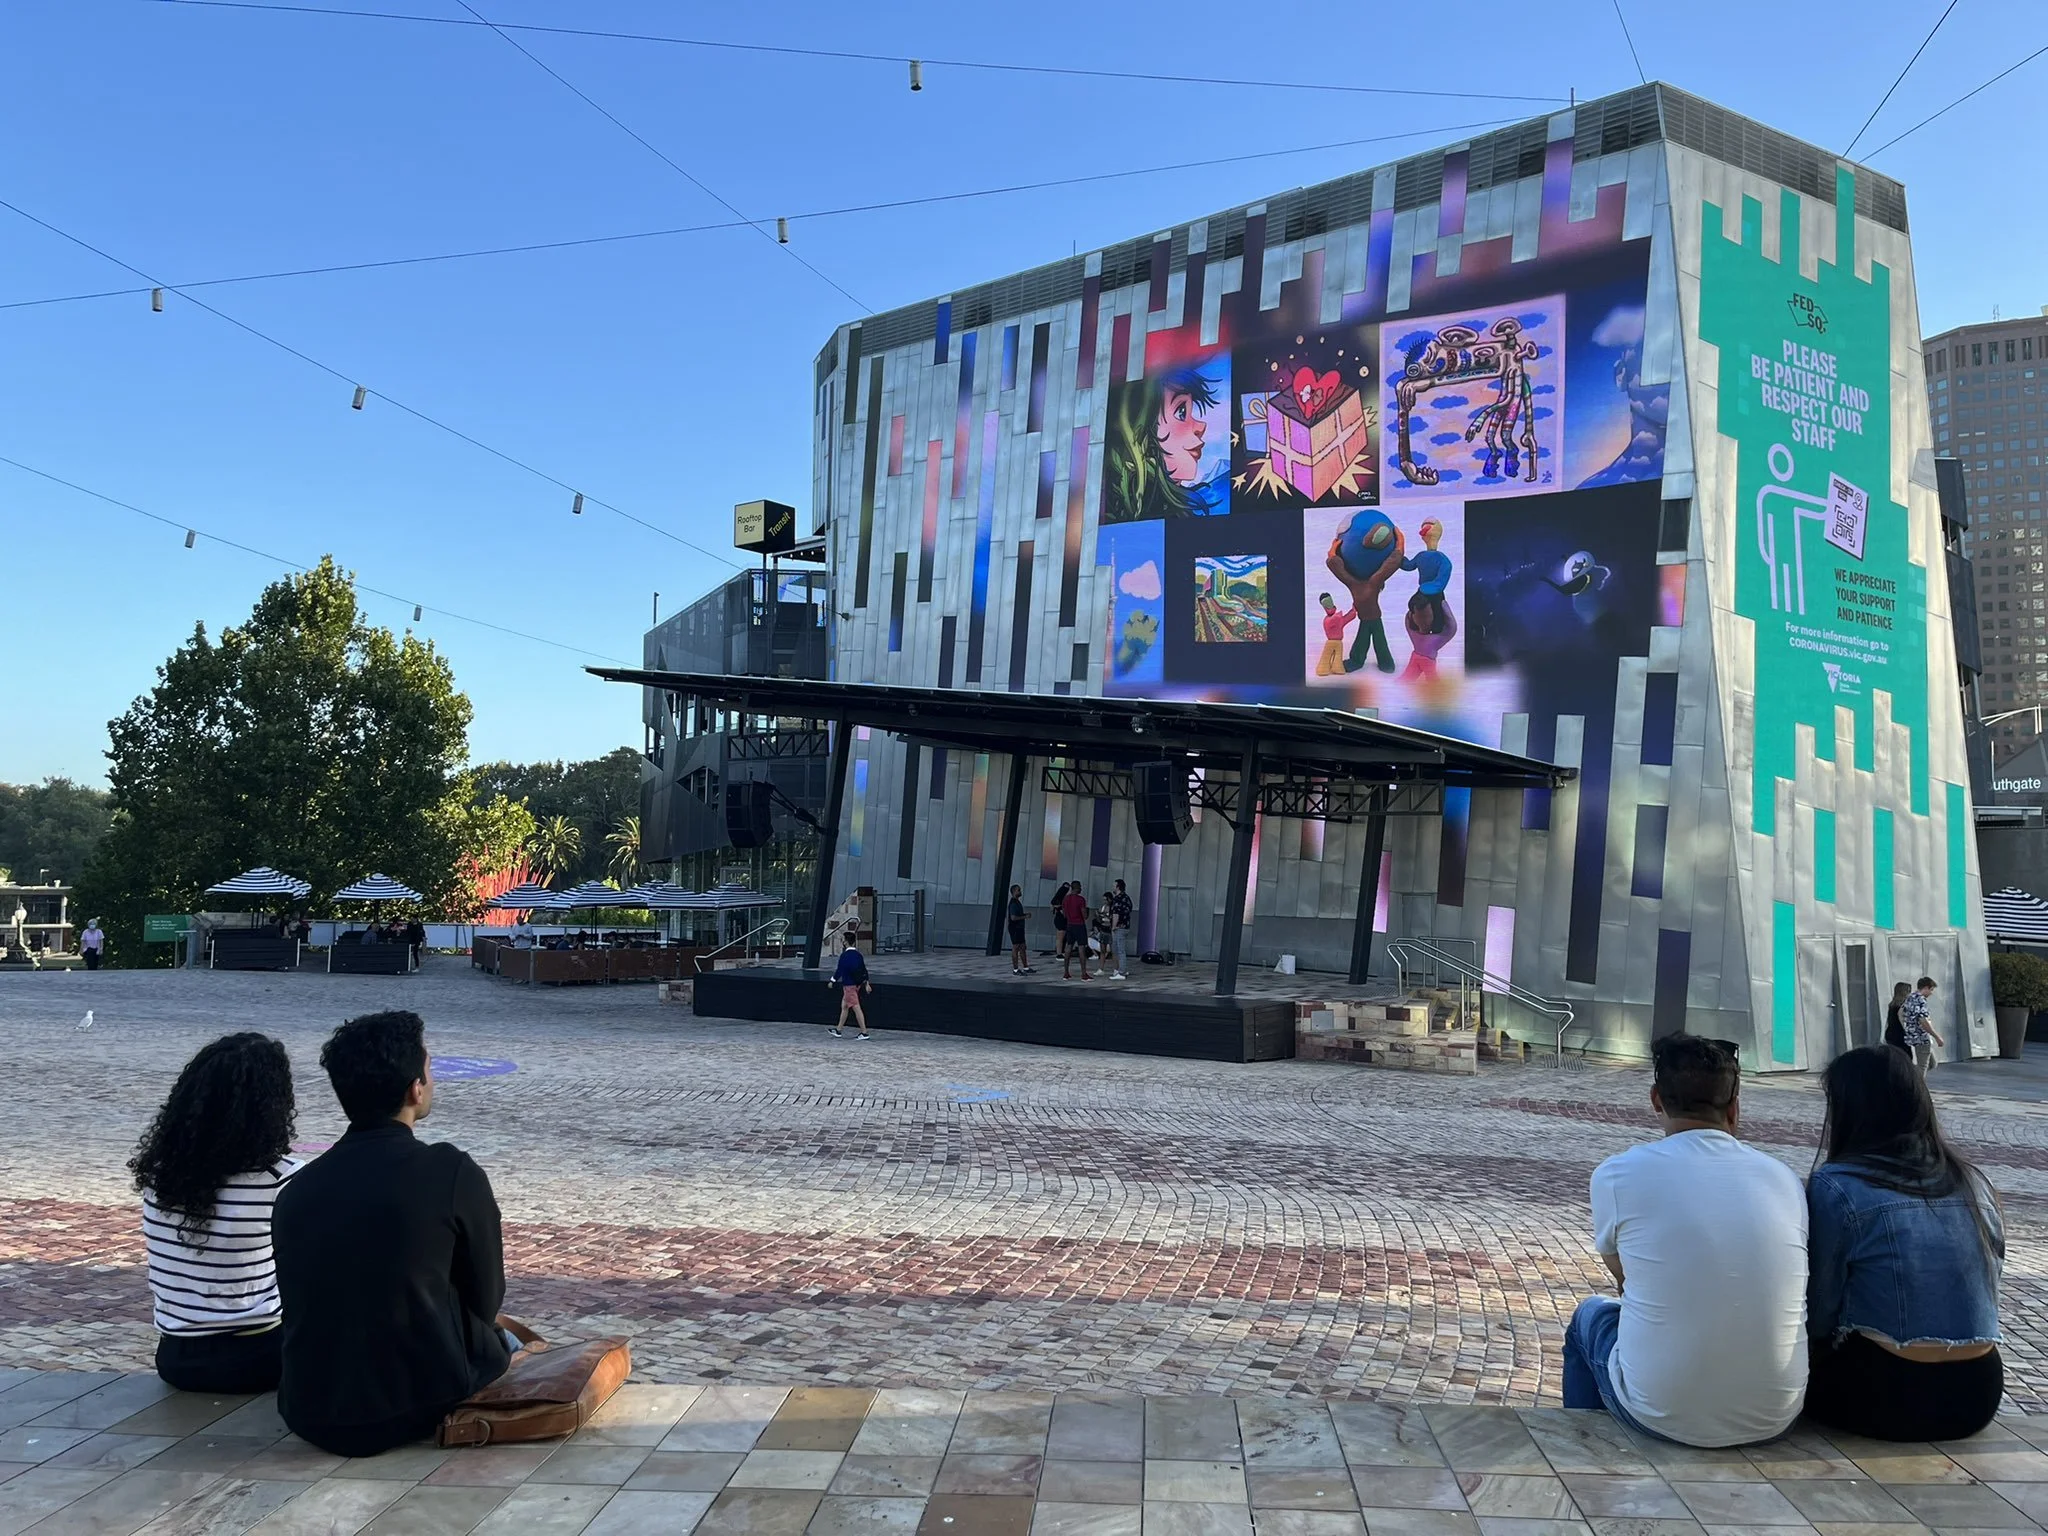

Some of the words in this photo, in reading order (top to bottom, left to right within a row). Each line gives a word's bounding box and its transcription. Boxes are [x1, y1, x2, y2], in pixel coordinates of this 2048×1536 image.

[1792, 293, 1814, 313] FED
[1783, 339, 1838, 378] PLEASE
[1751, 354, 1770, 382] BE
[1774, 361, 1835, 401] PATIENT
[1839, 383, 1869, 412] AND
[1761, 383, 1827, 424] RESPECT
[1831, 405, 1863, 435] OUR
[1791, 418, 1836, 451] STAFF
[737, 514, 763, 524] Rooftop
[743, 524, 756, 533] Bar
[768, 511, 791, 537] Transit
[1834, 568, 1847, 583] WE
[1849, 571, 1897, 595] APPRECIATE
[1835, 586, 1858, 604] YOUR
[1859, 593, 1896, 612] SUPPORT
[1837, 606, 1854, 622] AND
[1855, 610, 1893, 631] PATIENCE
[1785, 621, 1799, 634] For
[1800, 626, 1822, 638] more
[1822, 628, 1869, 648] information
[1870, 641, 1880, 651] go
[1880, 641, 1889, 652] to
[1789, 637, 1888, 665] CORONAVIRUS.vic.gov.au
[1992, 778, 2041, 793] uthgate
